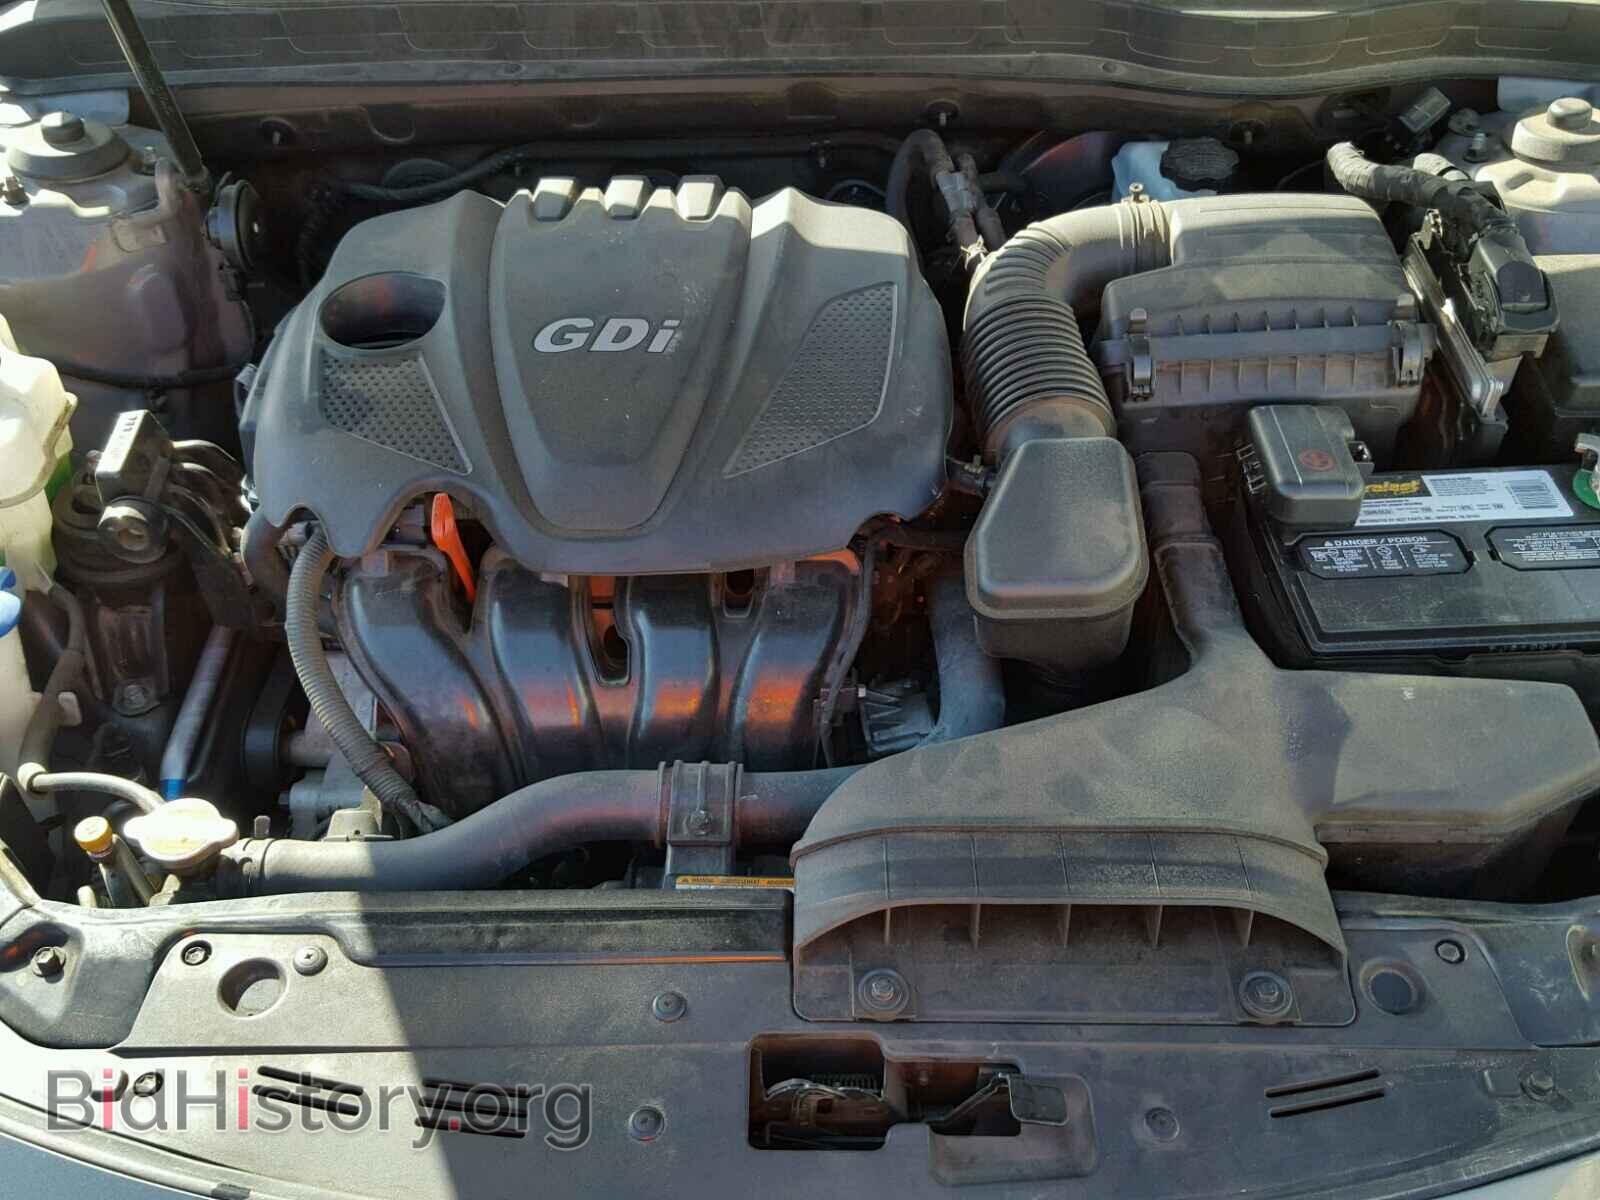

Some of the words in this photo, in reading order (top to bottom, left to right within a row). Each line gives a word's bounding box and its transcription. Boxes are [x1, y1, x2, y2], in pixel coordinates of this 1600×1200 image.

[533, 317, 681, 353] GDi
[1364, 480, 1422, 494] ralast
[1333, 538, 1377, 547] DANGER
[1388, 535, 1428, 544] POISON
